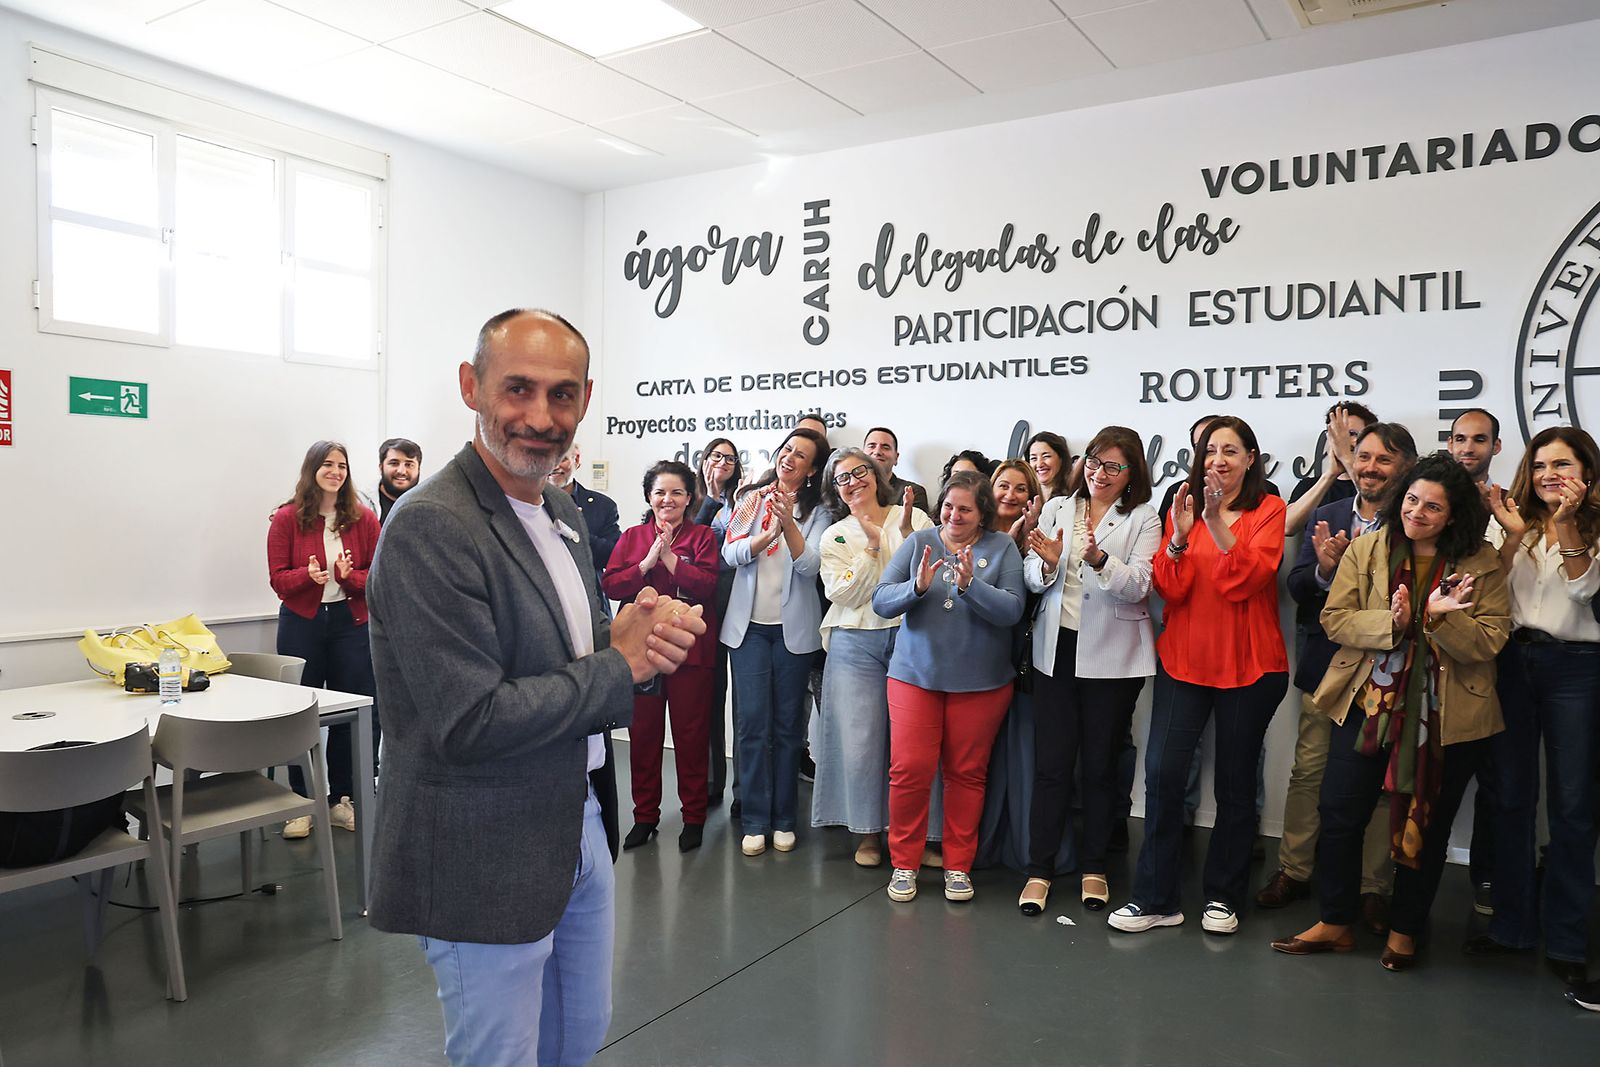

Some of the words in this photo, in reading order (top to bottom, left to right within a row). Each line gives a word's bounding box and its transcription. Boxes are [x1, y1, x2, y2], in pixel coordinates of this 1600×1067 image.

[1201, 114, 1600, 199] VOLUNTARIADO
[624, 224, 784, 319] ágora
[803, 198, 831, 346] CARUH
[858, 222, 1060, 299] delegadas
[1072, 212, 1125, 265] de
[1137, 202, 1241, 264] clase
[894, 284, 1158, 347] PARTICIPACIÓN
[1189, 270, 1482, 328] ESTUDIANTIL
[636, 378, 696, 397] CARTA
[703, 376, 732, 394] DE
[741, 367, 867, 392] DERECHOS
[877, 355, 1089, 385] ESTUDIANTILES
[1139, 360, 1370, 404] ROUTERS
[606, 415, 697, 439] Proyectos
